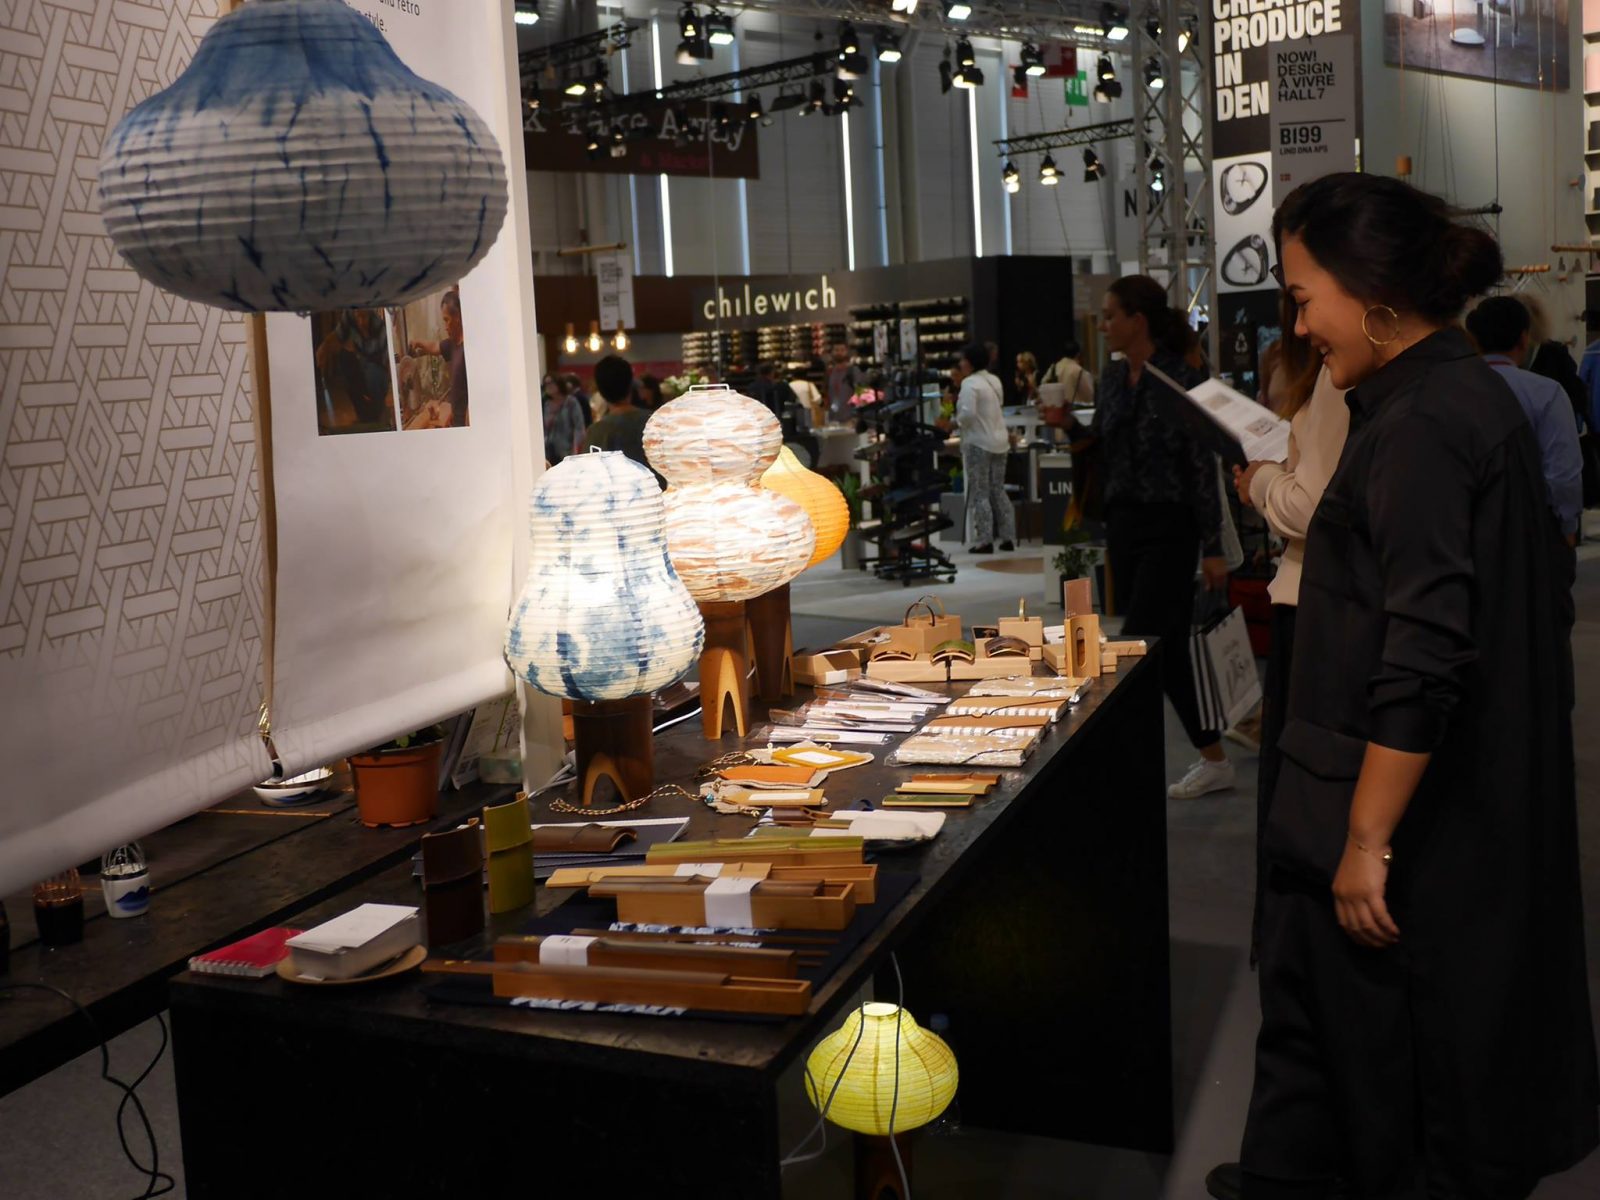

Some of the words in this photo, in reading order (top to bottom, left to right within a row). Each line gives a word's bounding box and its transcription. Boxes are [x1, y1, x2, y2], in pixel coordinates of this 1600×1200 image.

[397, 0, 421, 16] retro
[1214, 0, 1342, 54] PRODUCE
[1277, 50, 1317, 65] NOW!
[1215, 52, 1243, 87] IN
[1277, 62, 1333, 78] DESIGN
[1292, 74, 1336, 89] VIVRE
[1216, 81, 1270, 122] DEN
[1278, 88, 1317, 102] HALL
[1317, 88, 1325, 100] 7
[703, 275, 836, 320] chilewich
